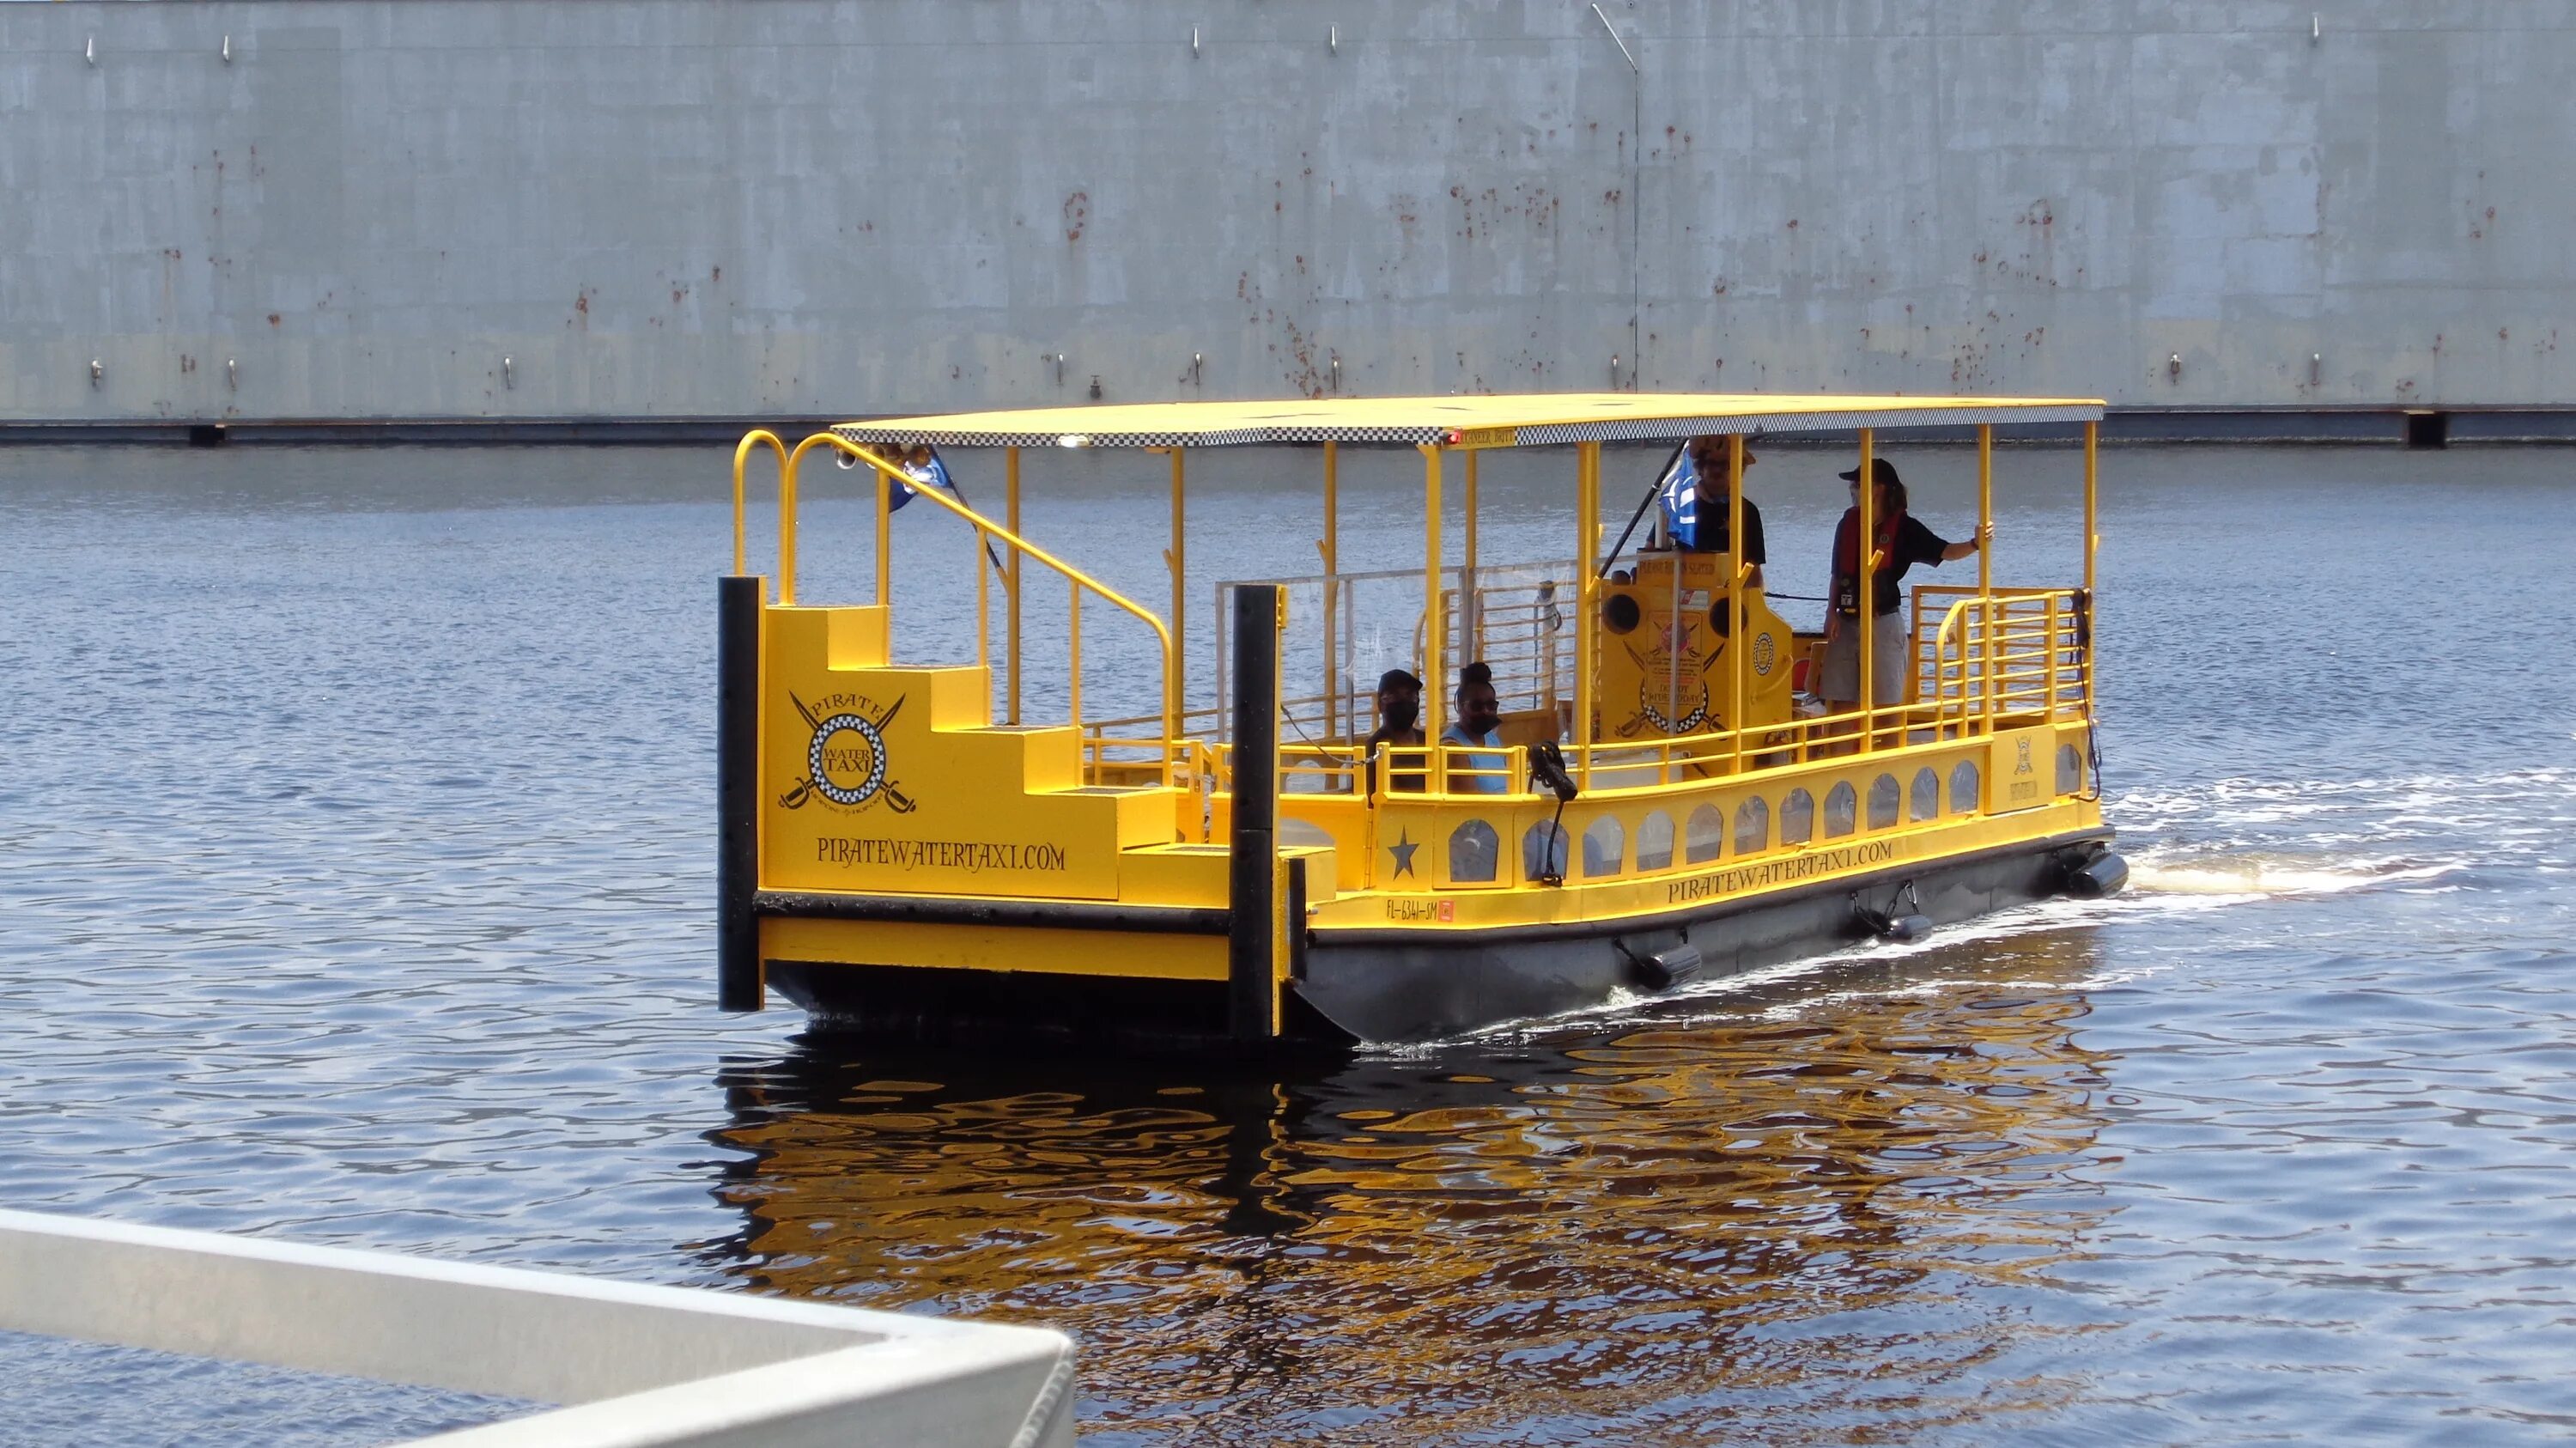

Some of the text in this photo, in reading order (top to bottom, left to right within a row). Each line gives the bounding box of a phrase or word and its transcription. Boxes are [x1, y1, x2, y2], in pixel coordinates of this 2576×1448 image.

[810, 692, 884, 721] PIRATE
[823, 748, 871, 759] WATER
[823, 758, 871, 772] TAXI
[817, 837, 1066, 873] PIRATEWATERTAXI.COM
[1668, 840, 1893, 904] PIRATEWATERTAXI.COM
